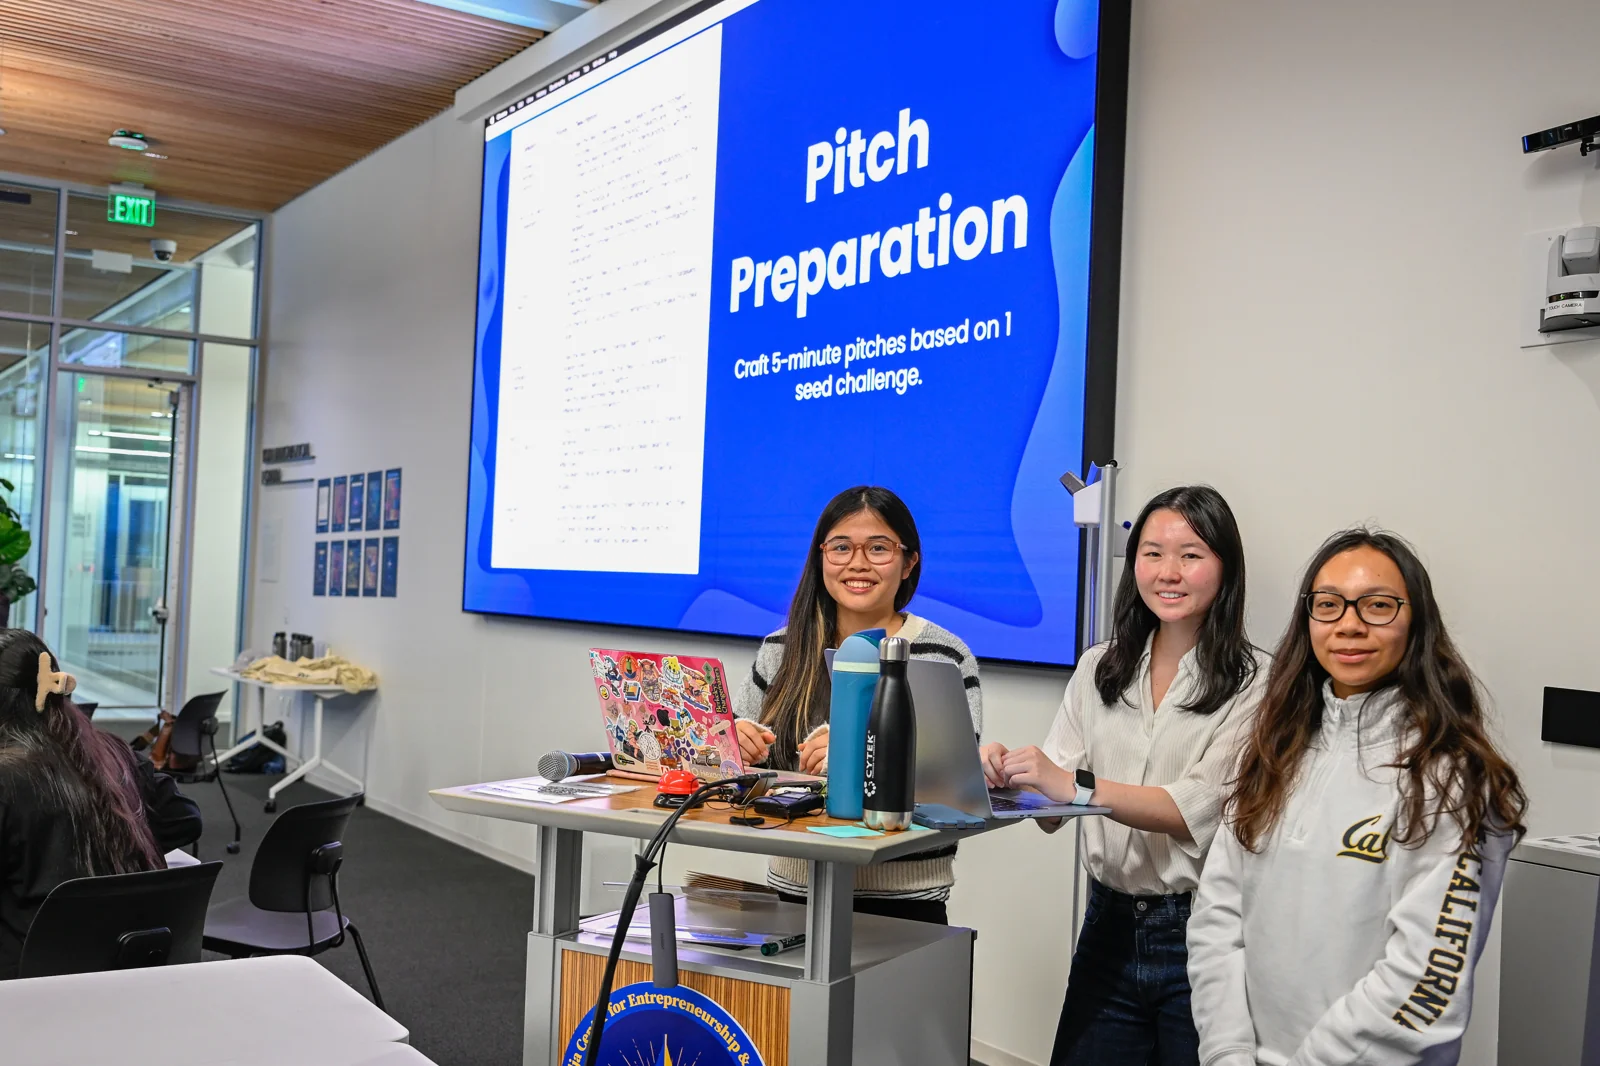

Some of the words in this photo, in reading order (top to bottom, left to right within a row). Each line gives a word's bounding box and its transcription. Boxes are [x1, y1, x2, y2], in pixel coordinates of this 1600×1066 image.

[805, 107, 930, 204] Pitch
[115, 195, 150, 224] EXIT
[729, 192, 1029, 319] Preparation
[734, 354, 770, 379] Craft
[771, 343, 842, 373] 5-minute
[844, 333, 907, 369] pitches
[910, 318, 969, 352] based
[973, 319, 1000, 342] on
[1004, 311, 1012, 337] 1
[794, 373, 833, 401] seed
[835, 366, 923, 396] challenge.
[865, 734, 874, 779] CYTEK
[1336, 814, 1393, 864] Cal
[607, 999, 627, 1017] for
[627, 991, 741, 1054] Entrepreneurship
[737, 1052, 750, 1066] &
